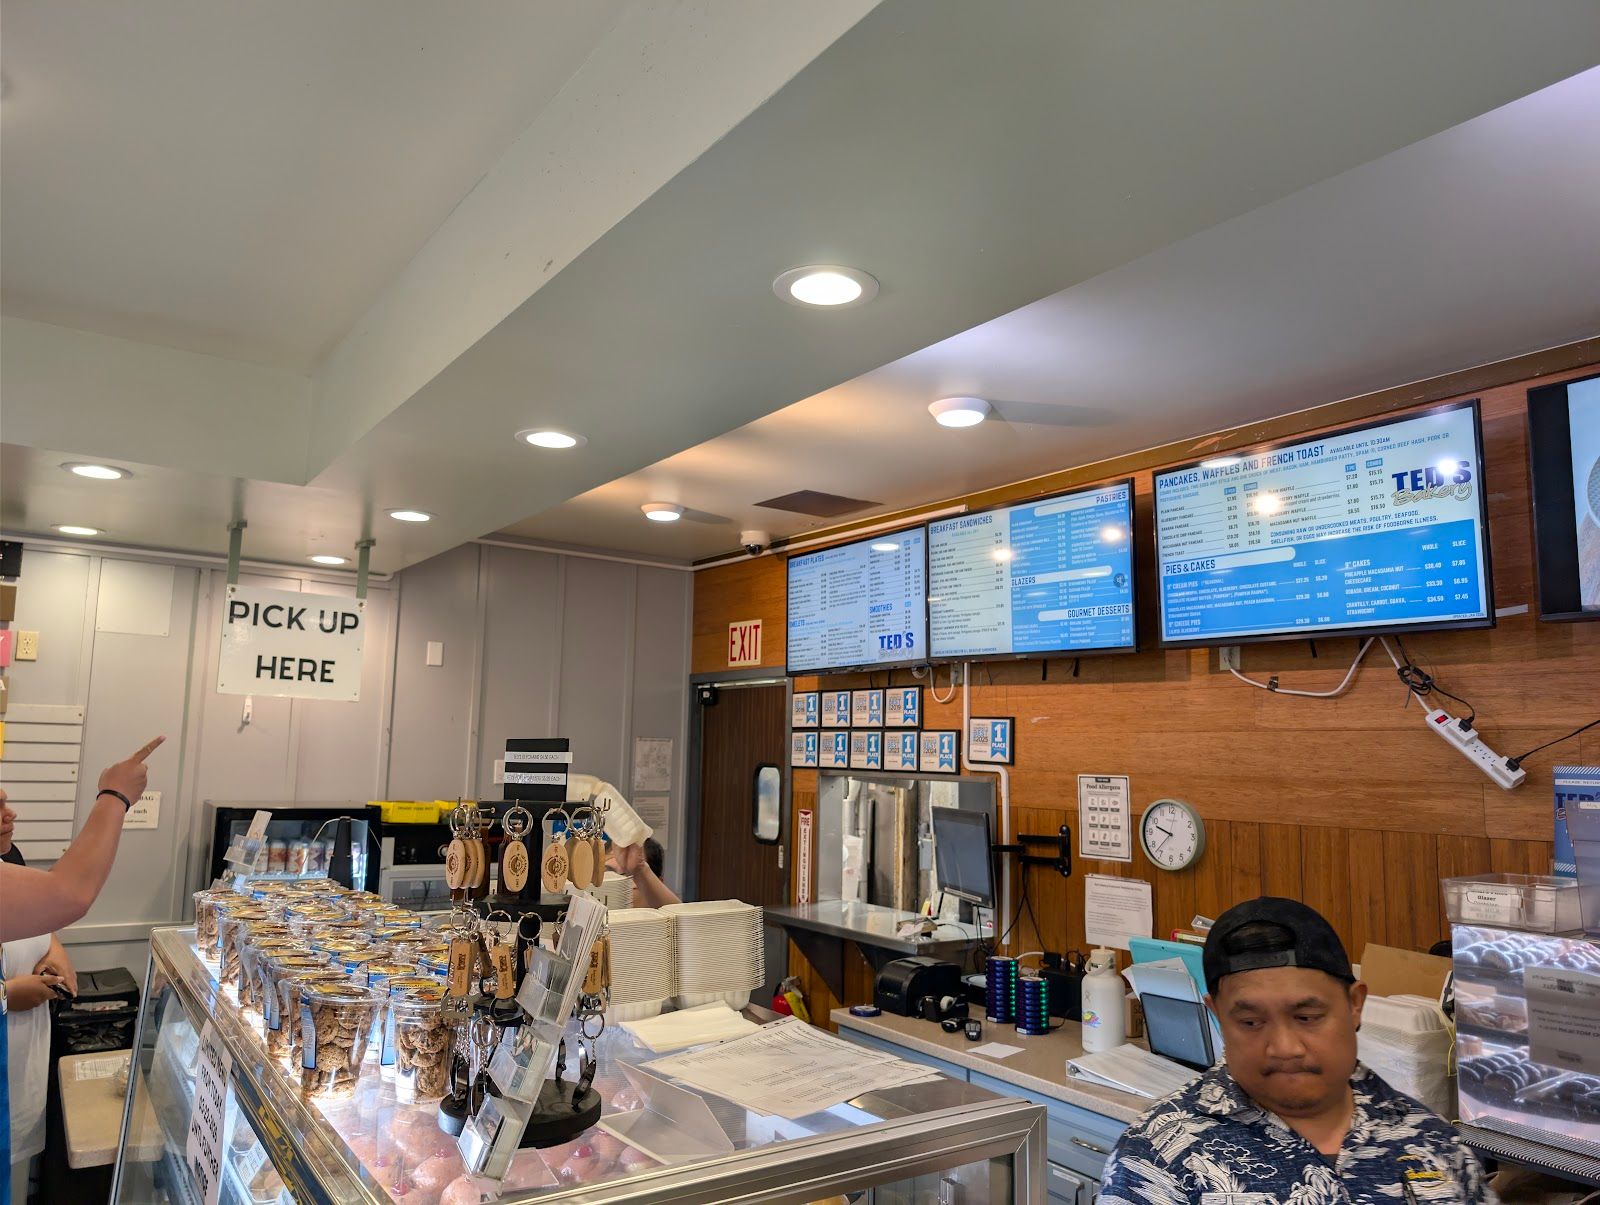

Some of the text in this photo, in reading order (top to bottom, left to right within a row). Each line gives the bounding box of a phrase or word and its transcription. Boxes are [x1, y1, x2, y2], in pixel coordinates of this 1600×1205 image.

[1397, 441, 1410, 450] BEEF
[1159, 472, 1200, 489] PANCAKES,
[1202, 463, 1240, 480] WAFFLES
[1243, 458, 1259, 472] AND
[1262, 451, 1294, 468] FRENCH
[1297, 445, 1325, 460] TOAST
[1329, 443, 1355, 454] AVAILABLE
[1355, 441, 1369, 450] UNTIL
[1096, 491, 1126, 503] PASTRIES
[1391, 481, 1473, 507] Bakery
[930, 515, 993, 535] BREAKFAST SANDWICHES
[1315, 521, 1349, 531] UNDERCOOKED
[1350, 517, 1369, 525] MEATS,
[1370, 514, 1392, 523] POULTRY,
[1352, 524, 1362, 532] THE
[1362, 523, 1375, 531] RISK
[1384, 517, 1414, 527] FOODBORNE
[1422, 543, 1438, 551] WHOLE
[1165, 559, 1216, 574] PIES & CAKES
[1352, 559, 1371, 567] CAKES
[1368, 567, 1393, 575] MACADAMIA
[870, 603, 893, 614] SMOOTHIES
[1067, 605, 1130, 618] GOURMET DESSERTS
[229, 600, 359, 634] PICK UP
[730, 625, 760, 661] EXIT
[256, 655, 335, 683] HERE
[1187, 821, 1192, 829] 2
[1160, 850, 1163, 858] 7
[1179, 853, 1184, 861] 5
